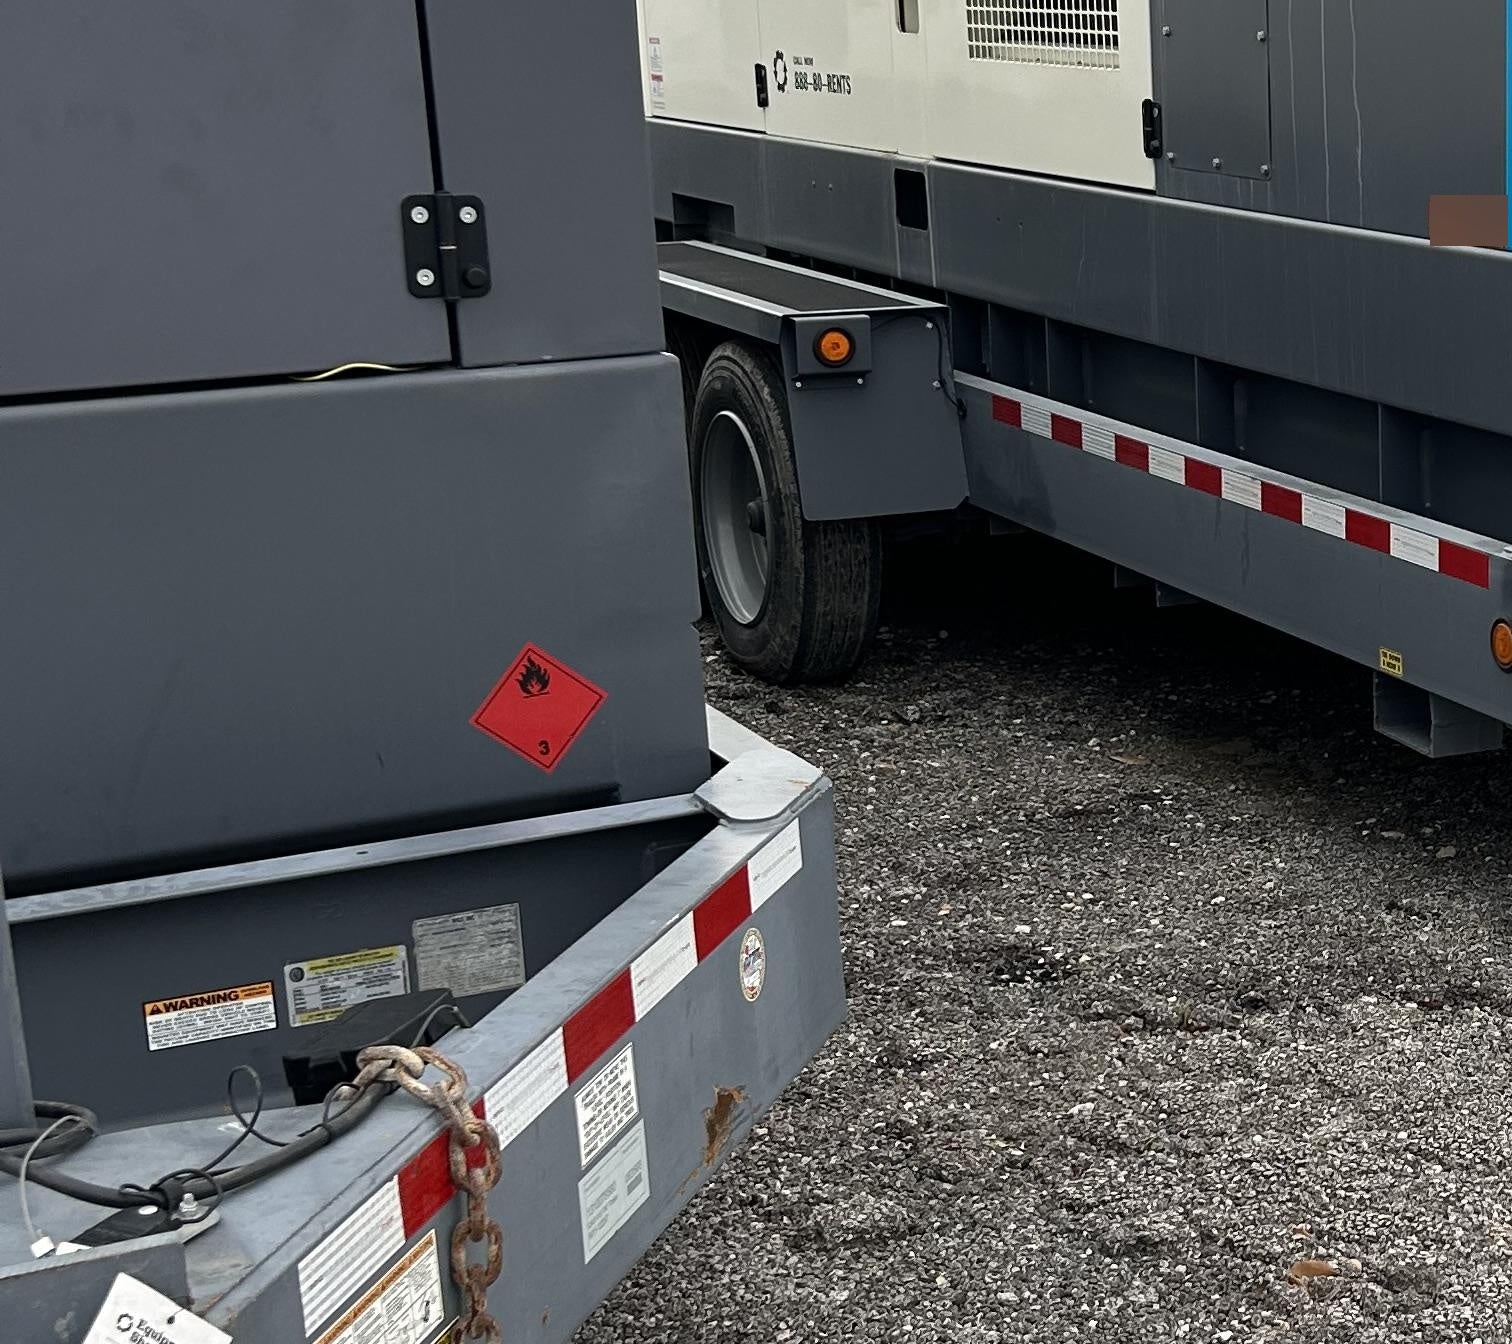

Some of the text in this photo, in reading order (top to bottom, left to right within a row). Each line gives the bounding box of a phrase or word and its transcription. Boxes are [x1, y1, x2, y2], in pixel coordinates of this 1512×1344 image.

[794, 70, 851, 95] 888-80-RENTS
[537, 739, 551, 756] 3
[163, 990, 240, 1012] WARNING
